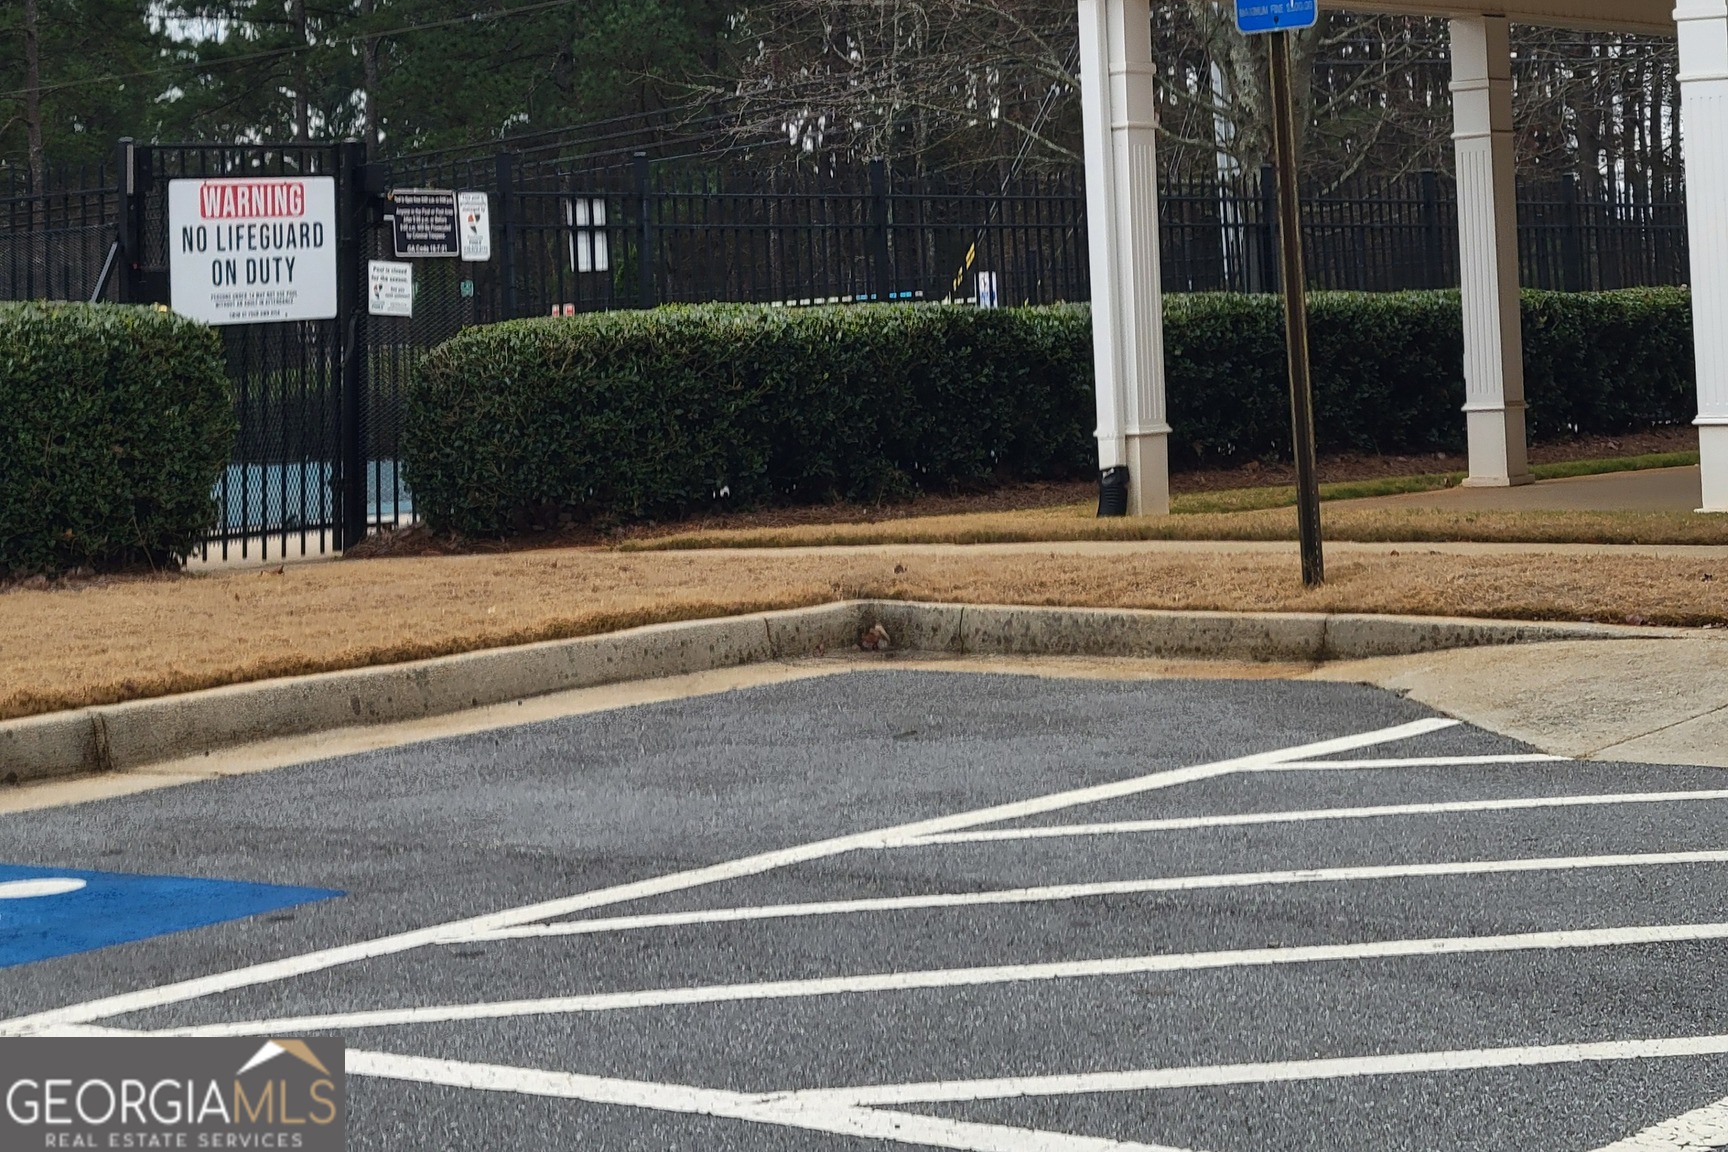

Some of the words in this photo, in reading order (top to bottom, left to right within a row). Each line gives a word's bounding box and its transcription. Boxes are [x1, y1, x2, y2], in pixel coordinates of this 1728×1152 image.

[1239, 6, 1268, 17] MAXIMUM
[1271, 4, 1283, 13] FINE
[203, 185, 302, 217] WARNING
[182, 225, 207, 253] NO
[217, 222, 323, 252] LIFEGUARD
[212, 258, 236, 286] ON
[246, 256, 296, 285] DUTY
